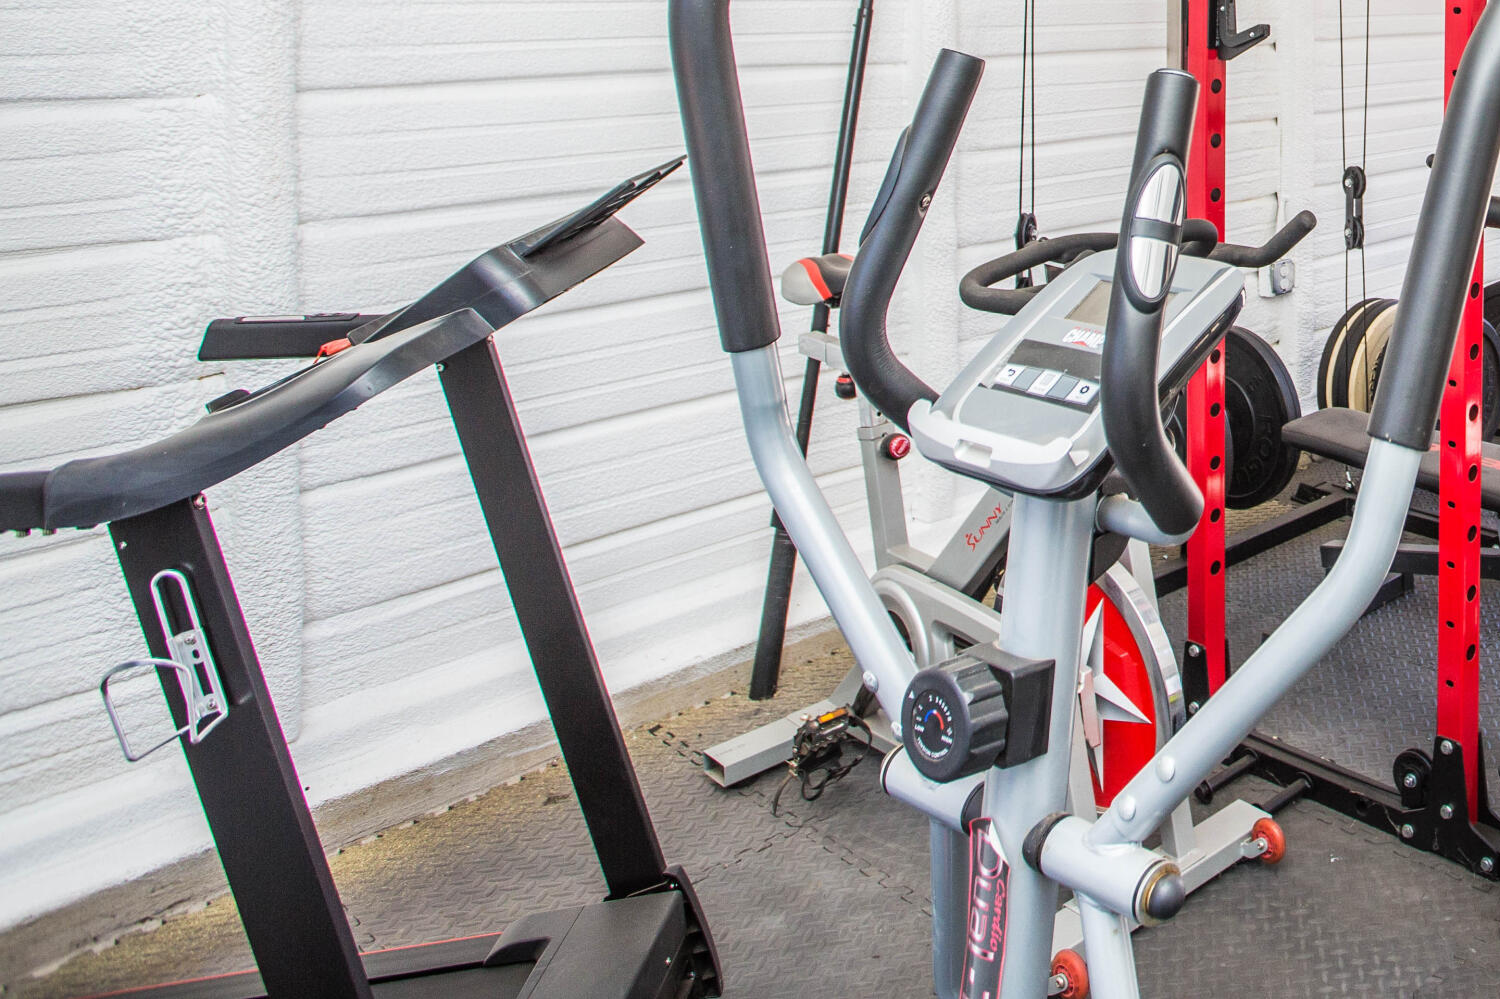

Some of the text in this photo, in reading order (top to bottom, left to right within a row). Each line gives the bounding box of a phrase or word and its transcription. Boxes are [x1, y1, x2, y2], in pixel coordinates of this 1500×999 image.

[965, 502, 1002, 552] SUNNY
[968, 828, 1004, 962] Dual
[990, 879, 1006, 953] Cardio
